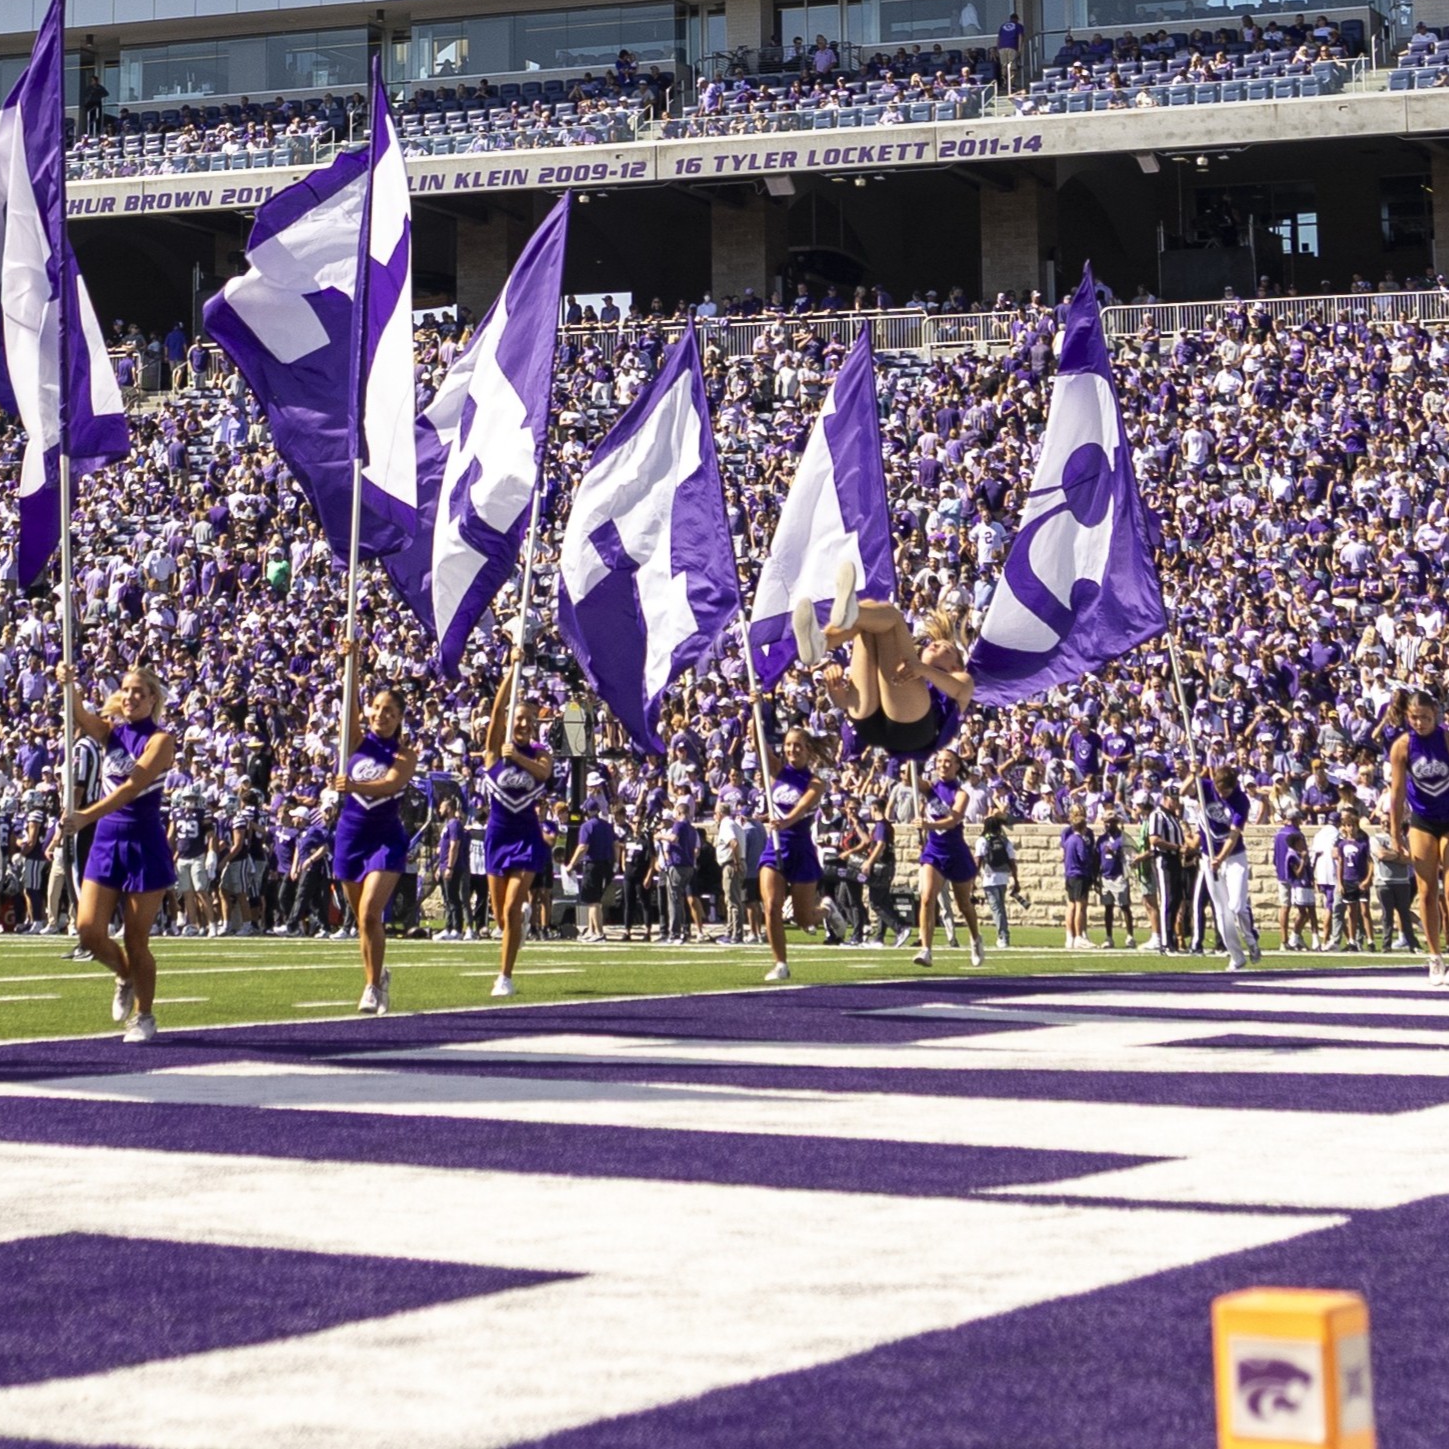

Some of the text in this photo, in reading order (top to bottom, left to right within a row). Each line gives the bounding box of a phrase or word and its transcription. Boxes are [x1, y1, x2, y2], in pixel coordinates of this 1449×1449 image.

[675, 134, 1044, 175] 16 TYLER LOCKETT 2011-14
[407, 161, 647, 192] LIN KLEIN 2009-12
[66, 185, 274, 215] HUR BROWN 2011
[176, 819, 200, 839] 39
